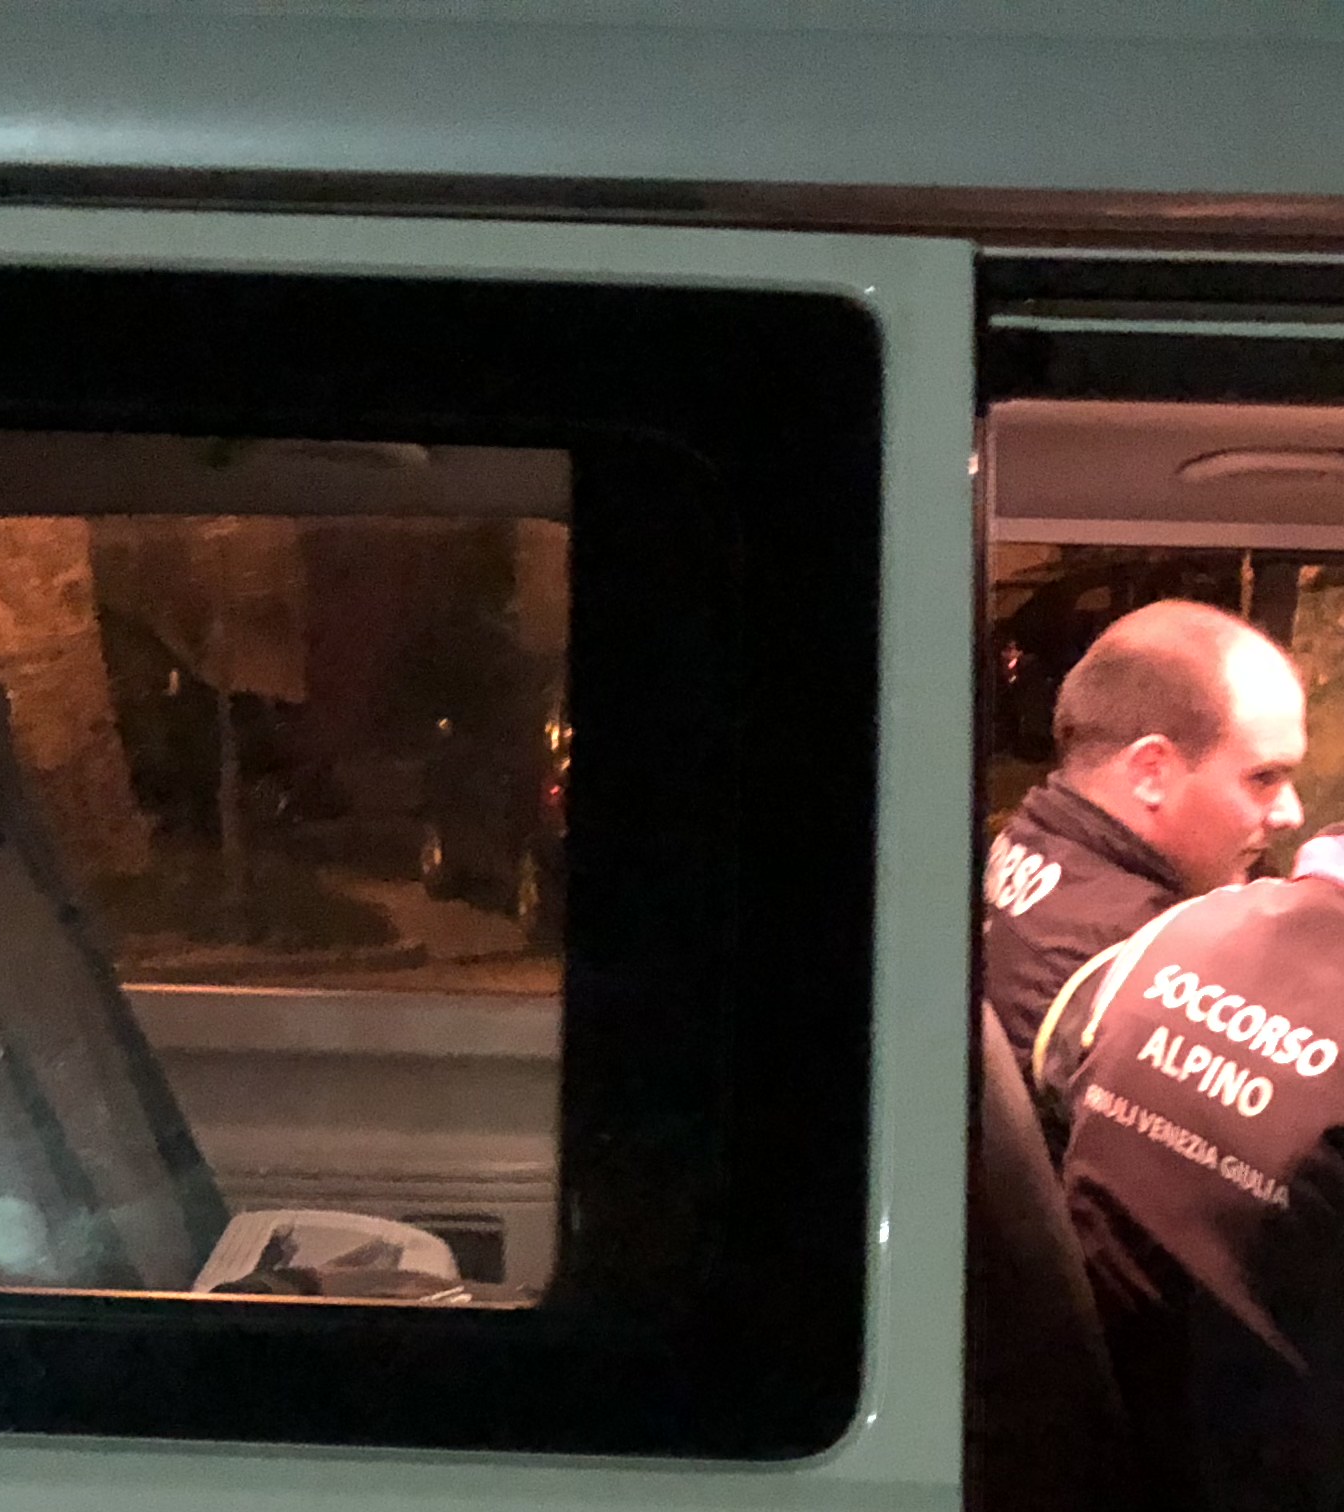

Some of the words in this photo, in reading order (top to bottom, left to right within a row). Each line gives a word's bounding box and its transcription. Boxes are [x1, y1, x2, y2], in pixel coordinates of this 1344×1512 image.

[1137, 1026, 1274, 1117] ALPINO
[1142, 963, 1340, 1078] SOCCORSO
[1137, 1108, 1218, 1169] VENEZIA
[1220, 1155, 1290, 1210] GIULIA
